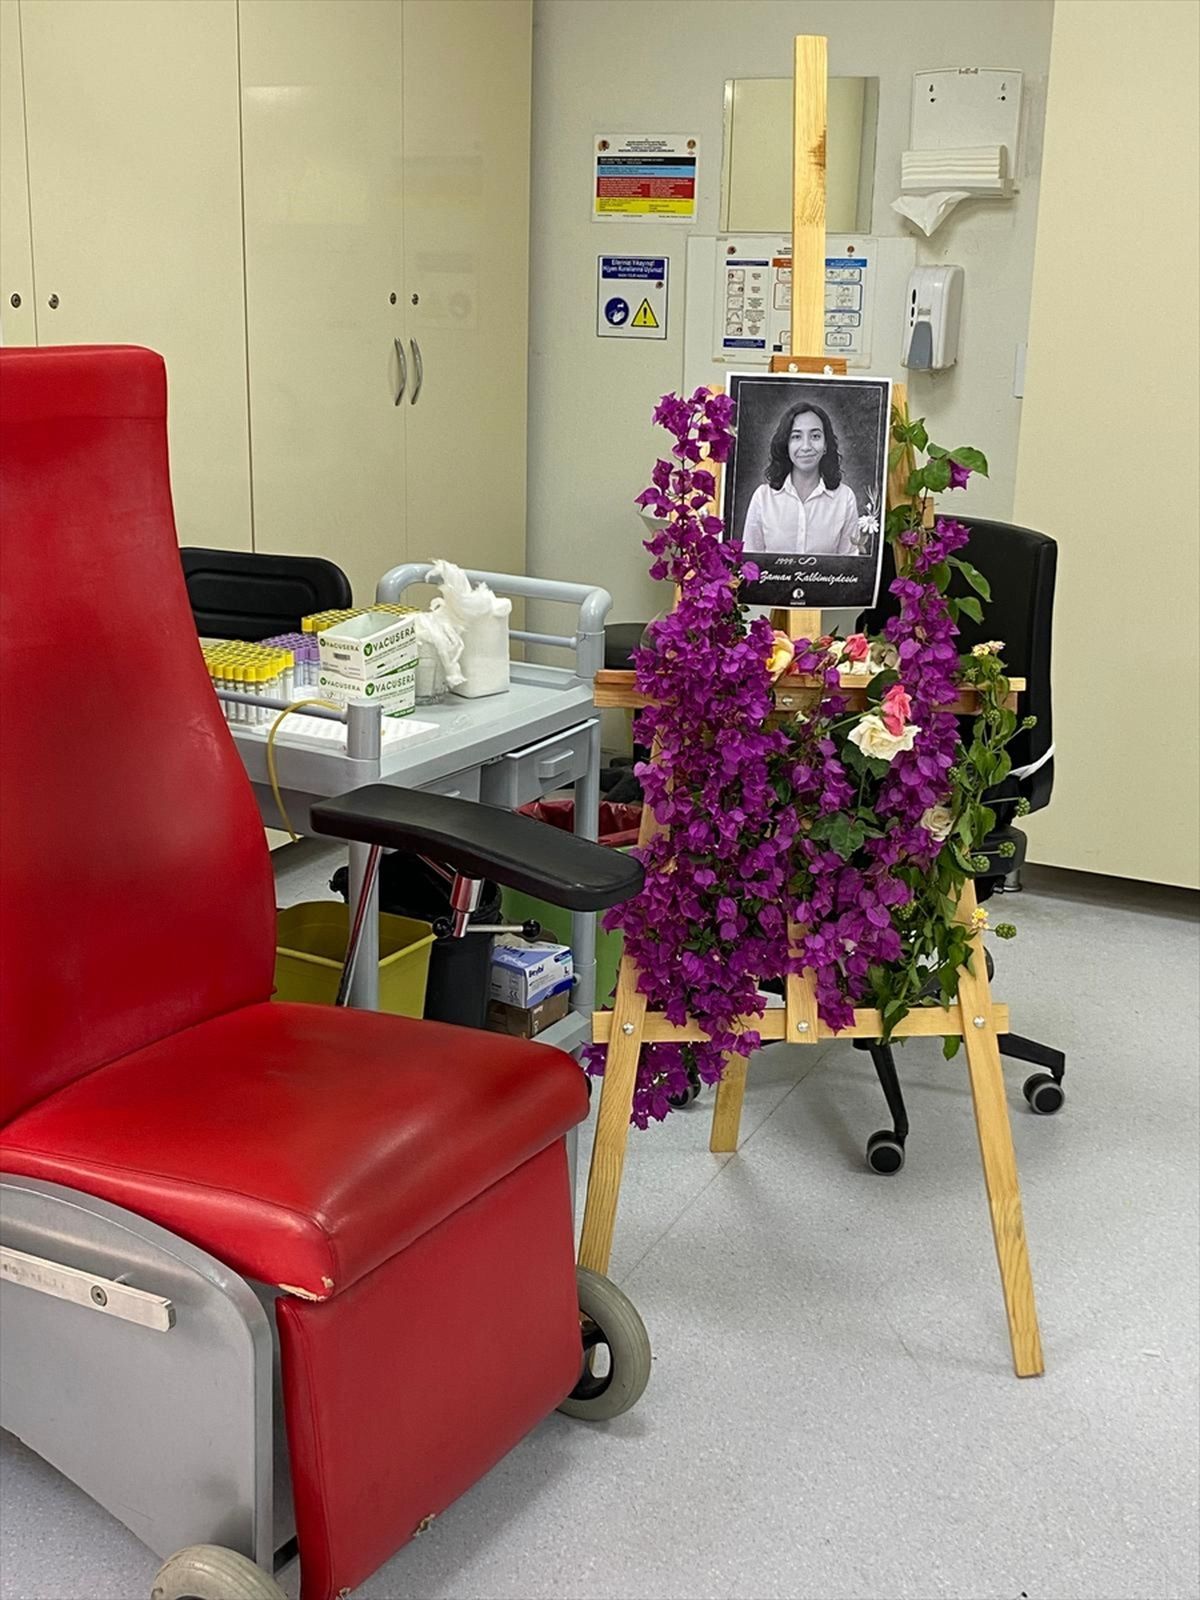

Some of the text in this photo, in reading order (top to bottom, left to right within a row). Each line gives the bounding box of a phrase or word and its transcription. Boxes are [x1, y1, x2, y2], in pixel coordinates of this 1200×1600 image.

[759, 570, 791, 584] Zaman
[794, 571, 858, 586] Kalbimizdesin
[373, 626, 415, 651] VACUSERA
[326, 642, 360, 652] VACUSERA
[327, 680, 361, 692] VACUSERA
[375, 675, 415, 692] VACUSERA
